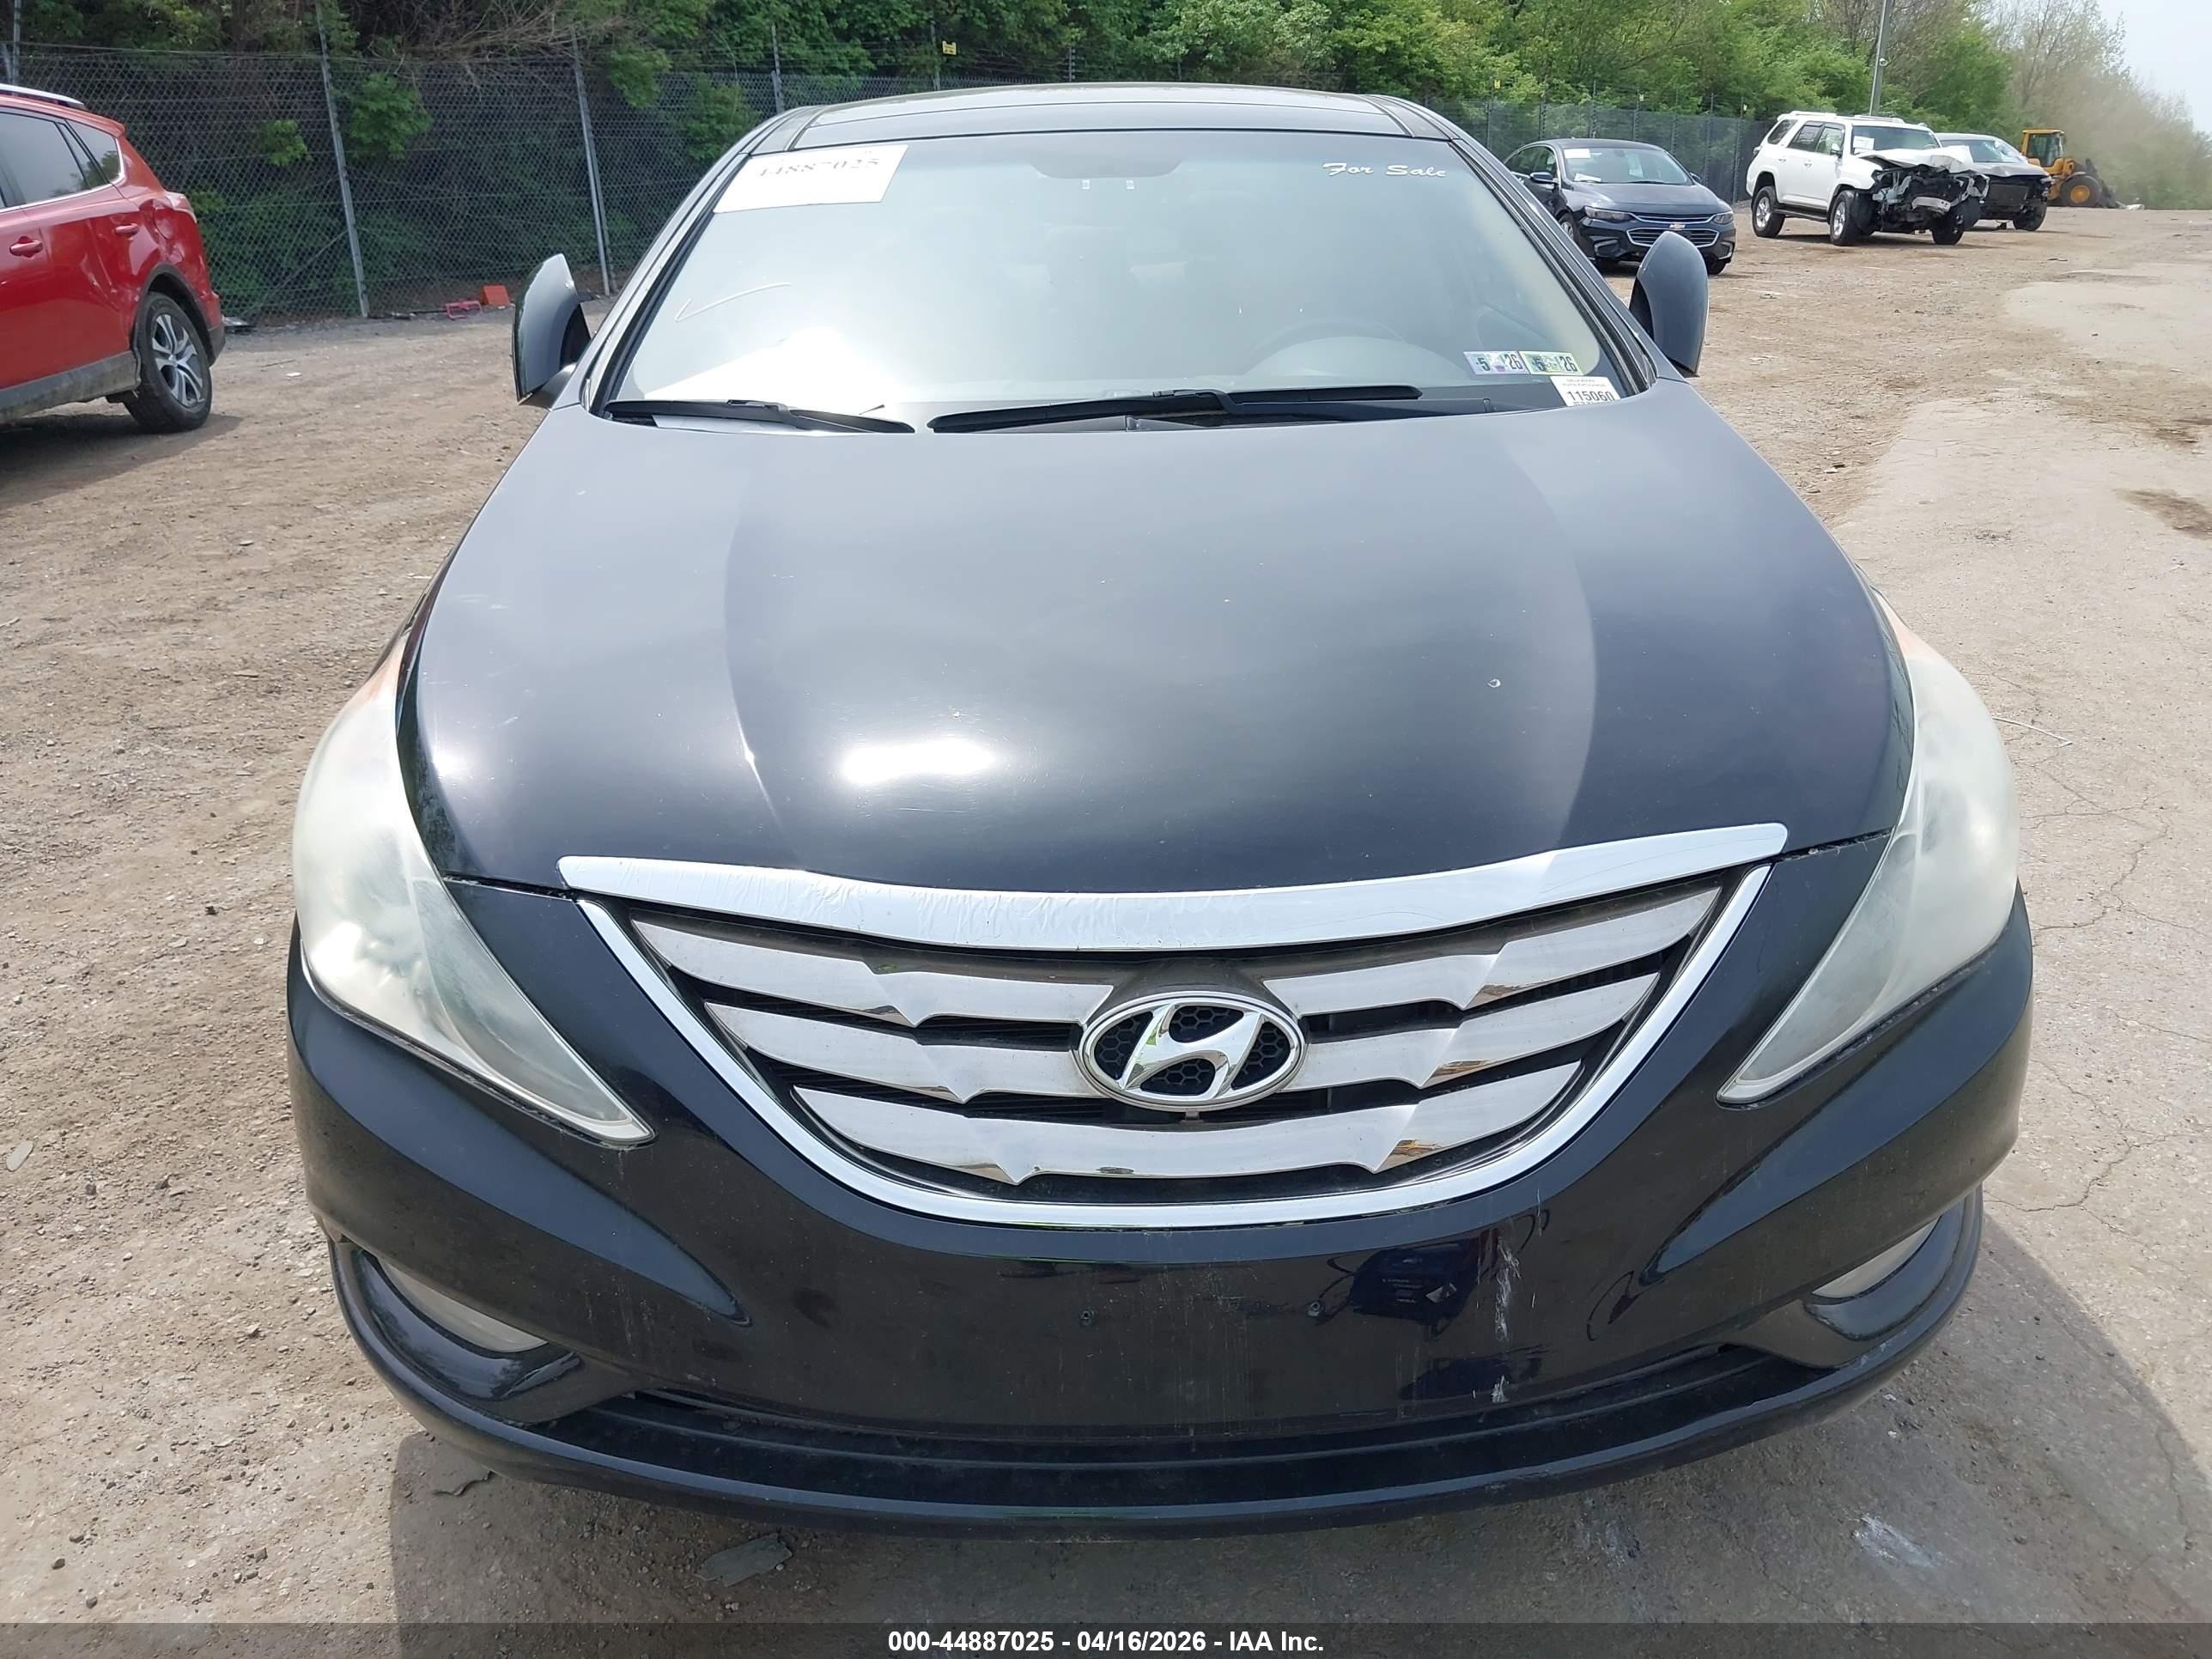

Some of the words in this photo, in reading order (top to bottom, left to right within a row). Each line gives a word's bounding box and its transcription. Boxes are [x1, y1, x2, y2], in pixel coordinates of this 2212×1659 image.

[1322, 162, 1374, 176] For
[1386, 164, 1447, 177] Sale
[1504, 354, 1523, 370] 26
[1559, 356, 1577, 372] 26
[1567, 390, 1615, 403] 115060
